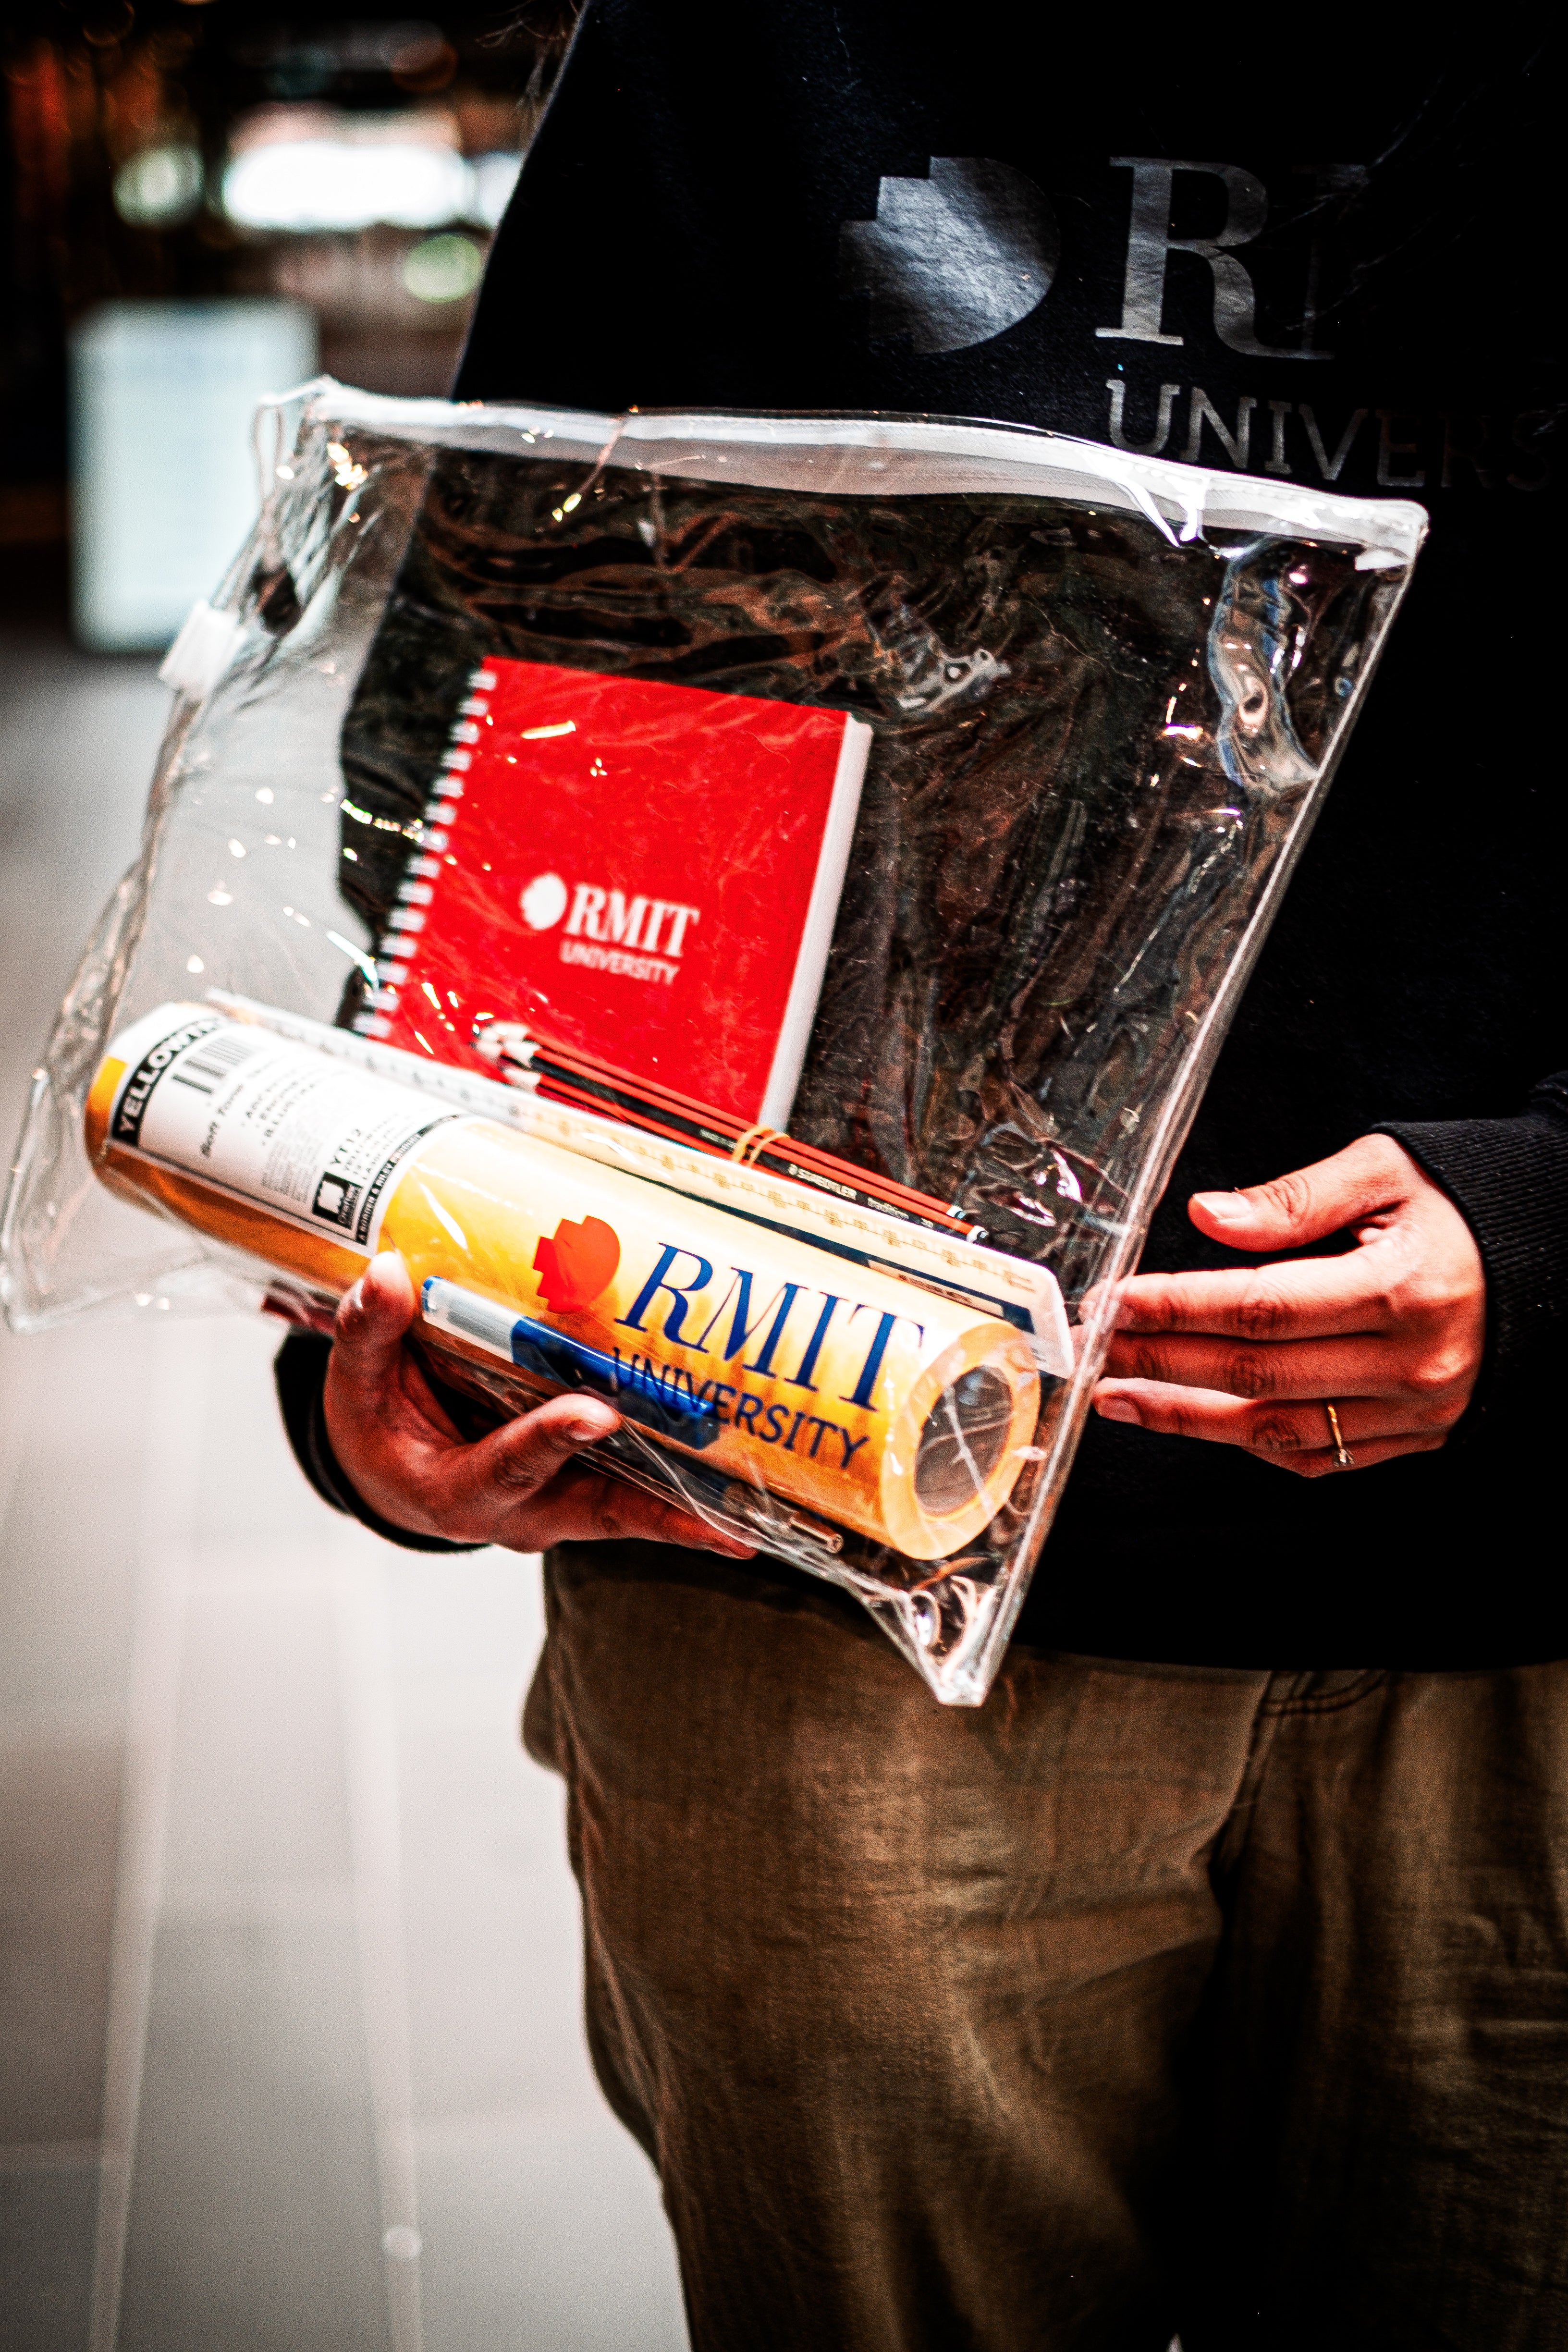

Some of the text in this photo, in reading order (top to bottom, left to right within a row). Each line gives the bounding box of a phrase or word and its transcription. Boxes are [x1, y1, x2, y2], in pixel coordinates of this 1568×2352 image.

[559, 939, 680, 985] UNIVERSITY
[563, 881, 701, 959] RMIT
[614, 1242, 925, 1413] RMIT
[611, 1346, 870, 1470] UNIVERSITY
